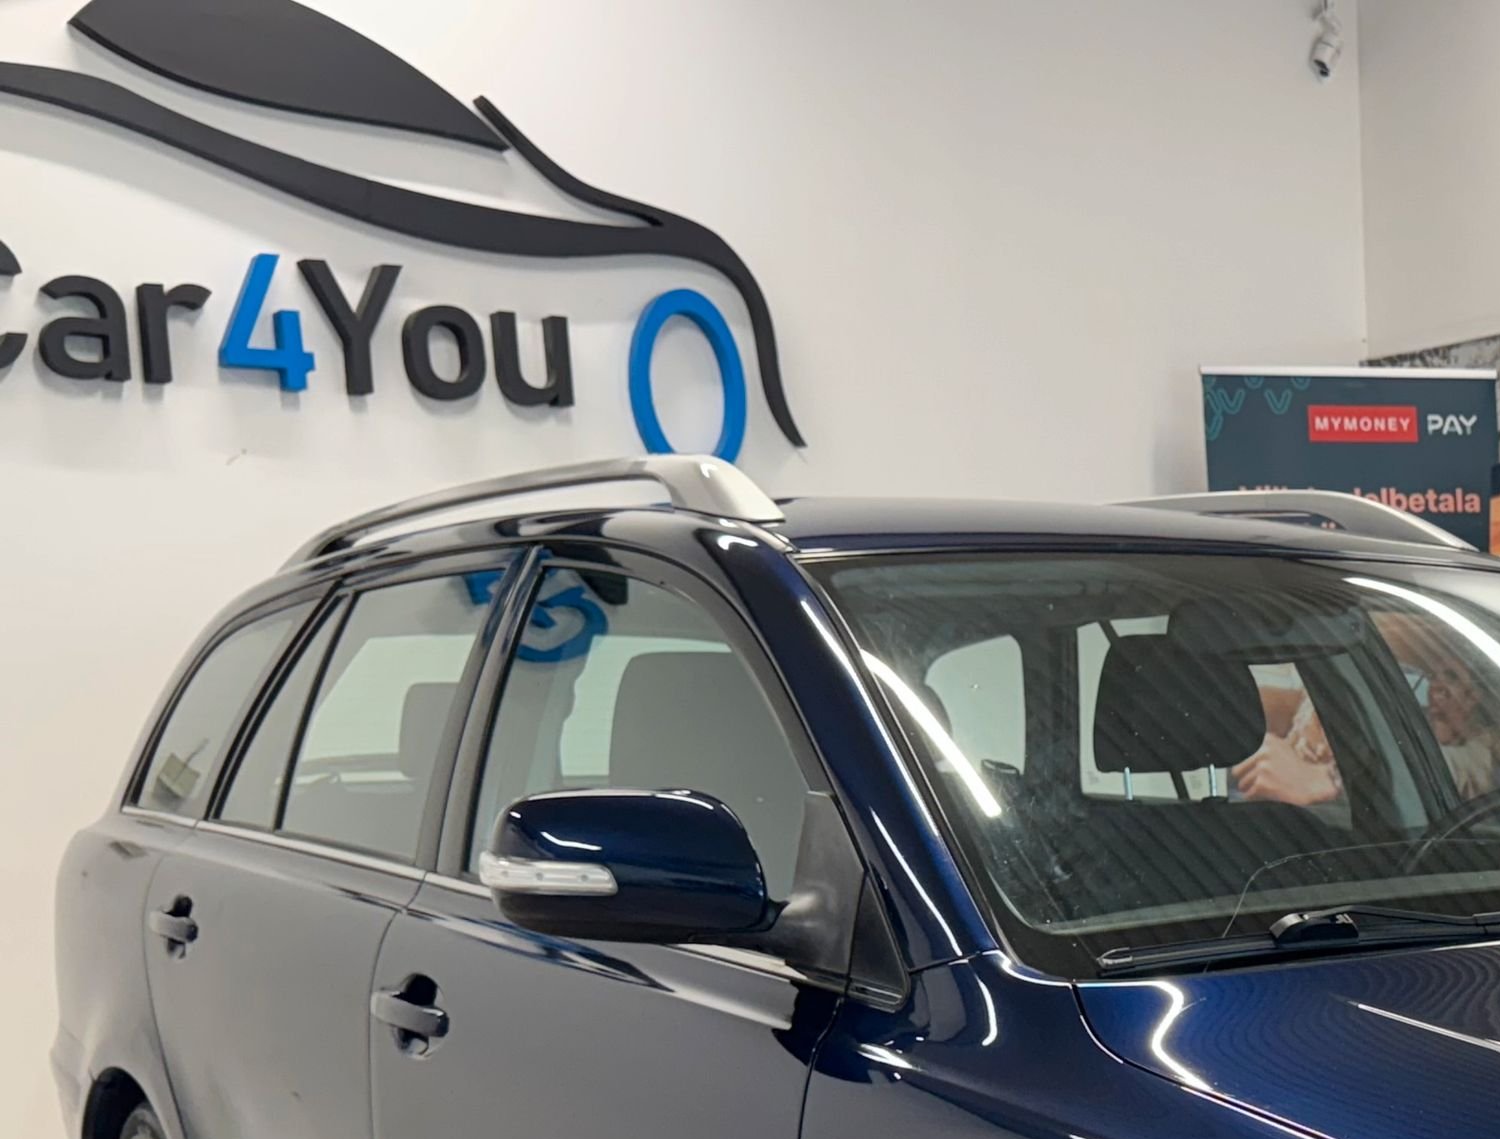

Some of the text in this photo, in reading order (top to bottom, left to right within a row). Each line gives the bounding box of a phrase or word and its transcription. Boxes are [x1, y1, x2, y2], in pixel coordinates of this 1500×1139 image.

[1314, 414, 1478, 435] MYMONEY PAY
[1353, 487, 1482, 514] lbetala
